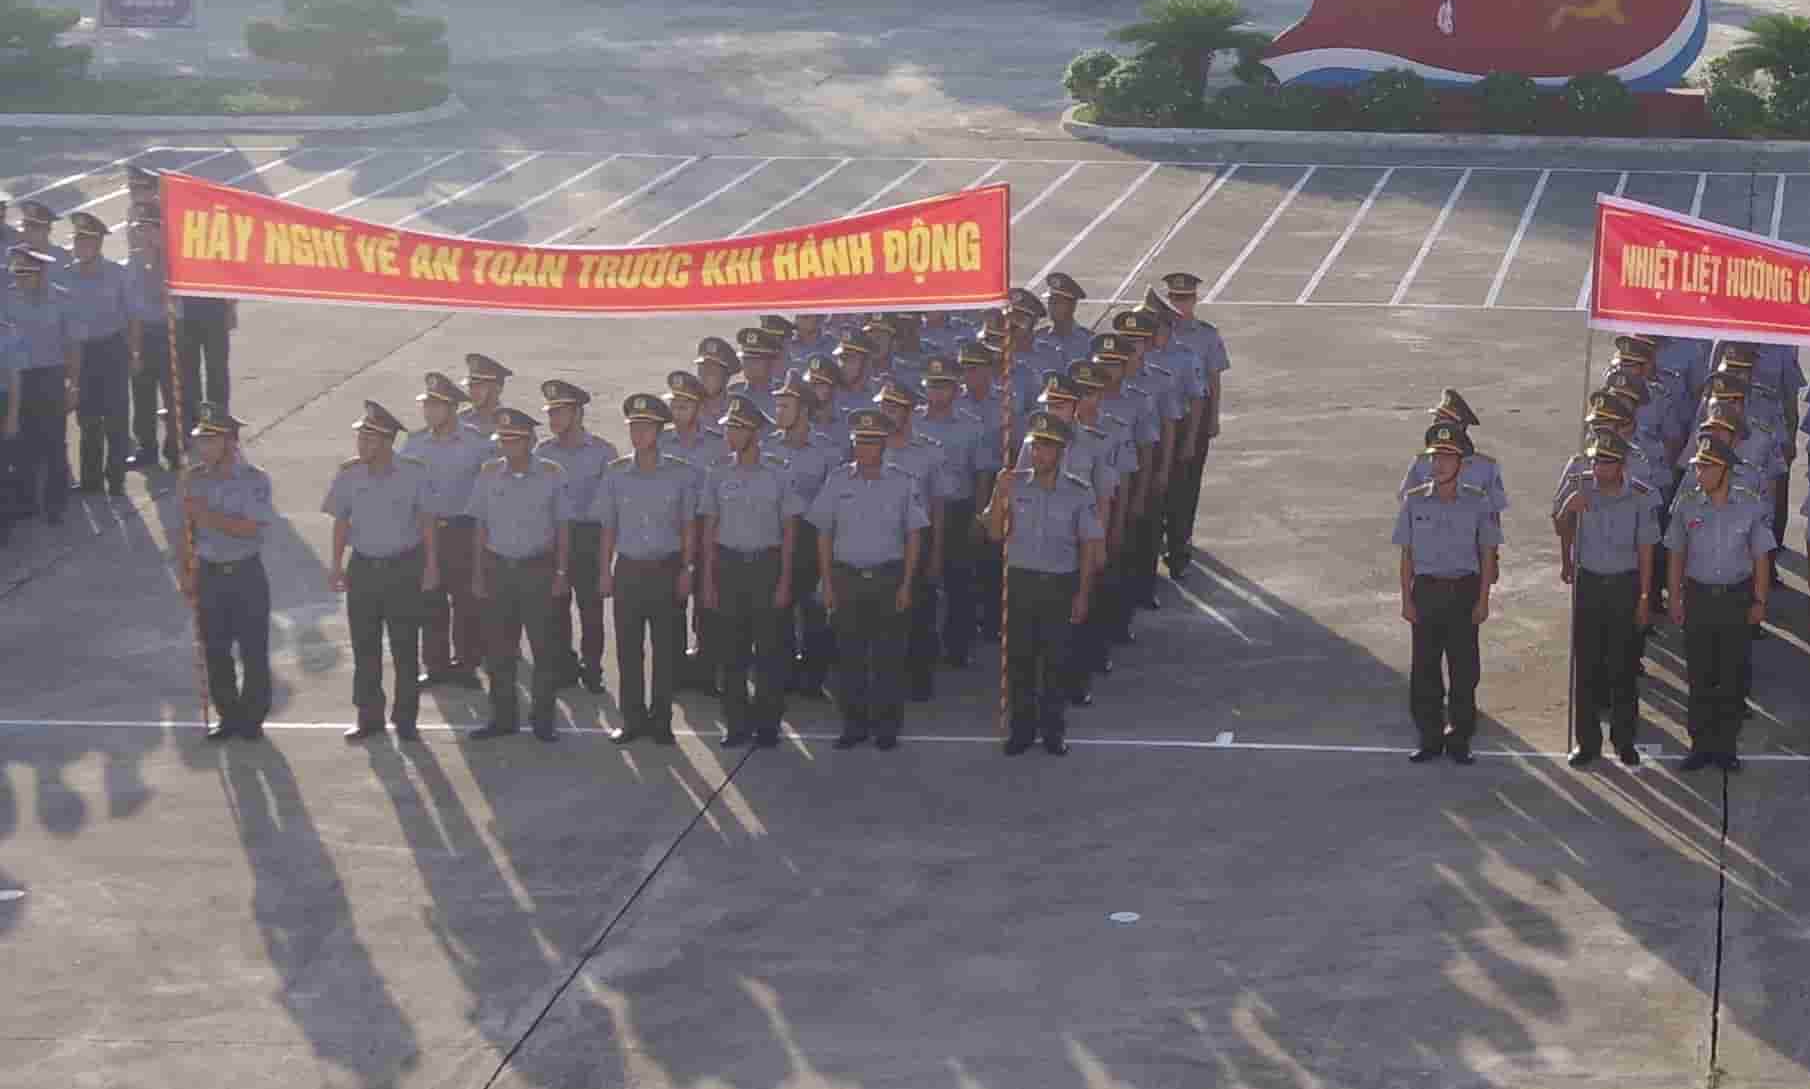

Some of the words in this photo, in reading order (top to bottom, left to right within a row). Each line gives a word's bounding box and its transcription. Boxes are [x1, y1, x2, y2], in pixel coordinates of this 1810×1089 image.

[181, 203, 254, 262] HÃY
[356, 231, 401, 276] VỀ
[410, 243, 464, 283] AN
[472, 247, 569, 289] TOÀN
[577, 247, 689, 289] TRƯỚC
[701, 245, 764, 287] KHI
[772, 233, 874, 281] HÀNH
[882, 217, 982, 284] ĐỘNG
[1620, 239, 1679, 303] NHIỆT
[1680, 244, 1722, 303] LIỆT
[1725, 255, 1793, 303] HƯỞNG
